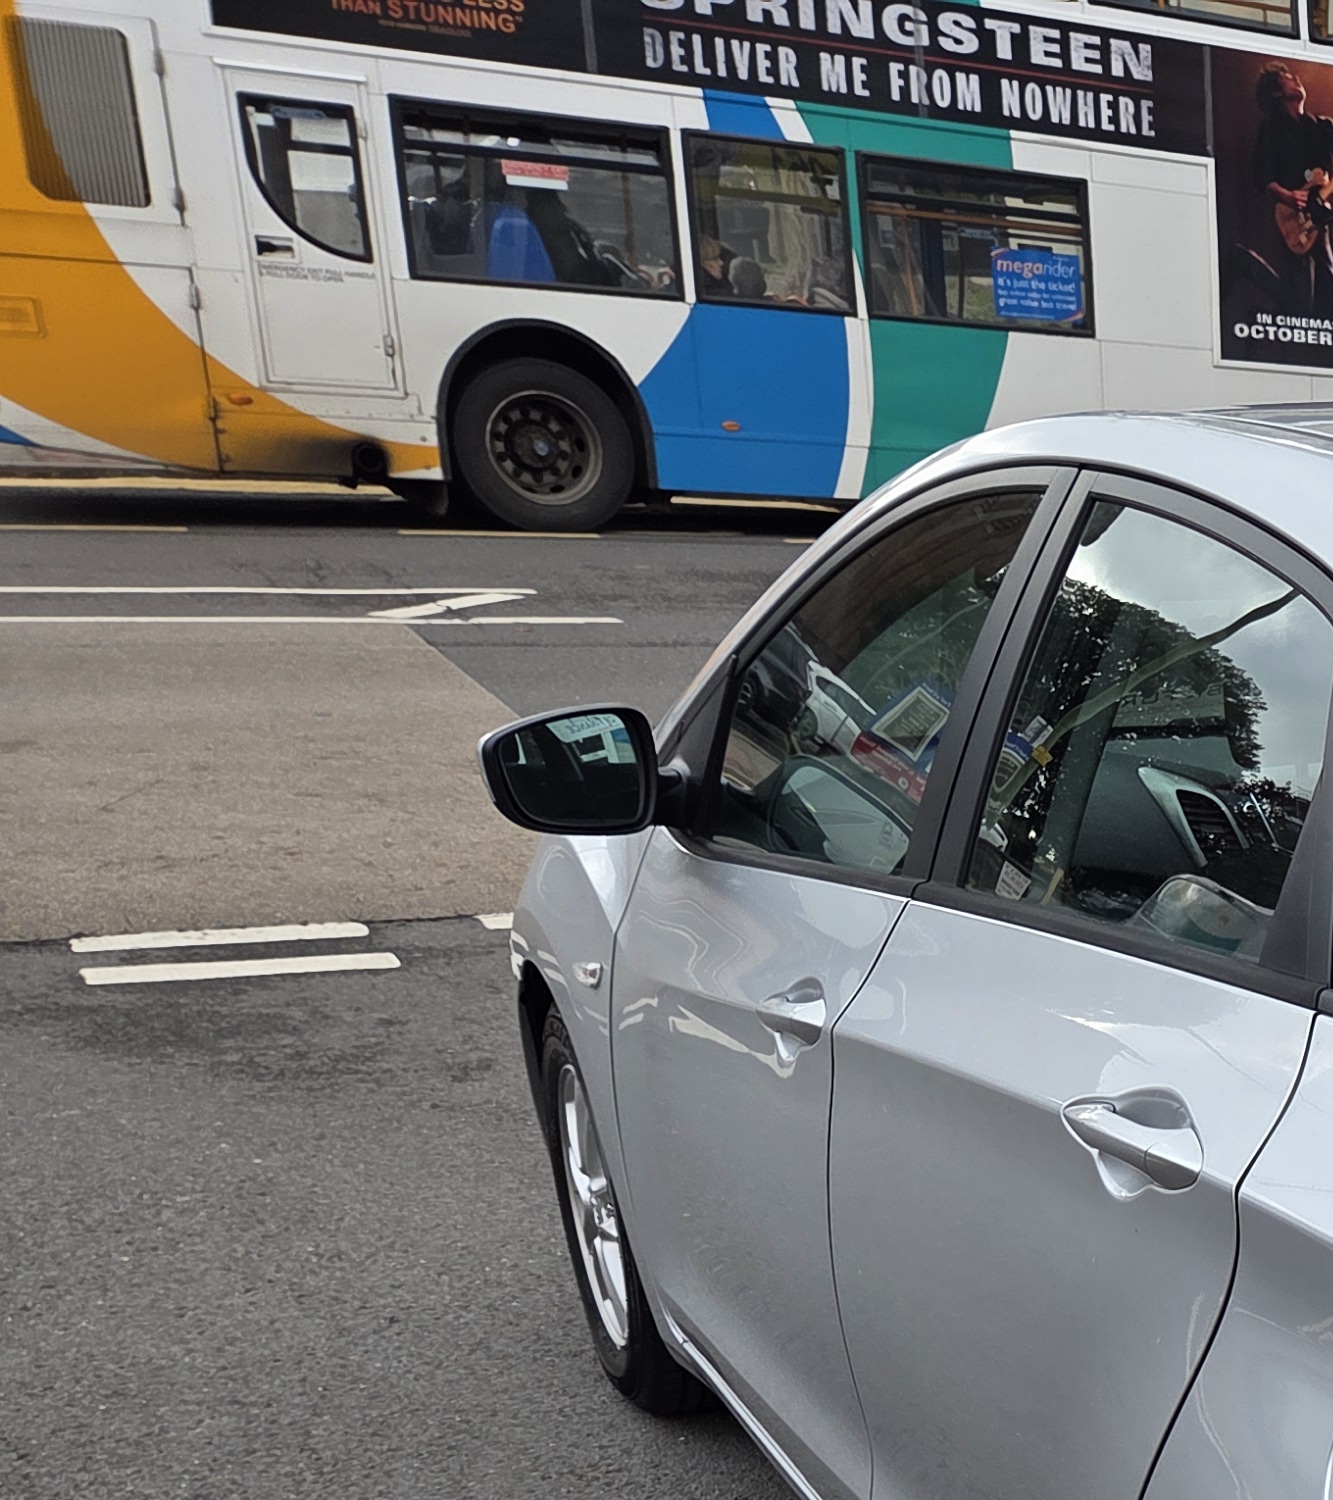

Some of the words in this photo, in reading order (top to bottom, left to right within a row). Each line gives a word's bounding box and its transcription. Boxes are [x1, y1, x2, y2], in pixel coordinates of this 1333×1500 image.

[388, 1, 516, 33] STUNNING
[641, 0, 1153, 82] RINGSTEEN
[643, 27, 799, 87] DELIVER
[820, 52, 870, 97] ME
[889, 62, 982, 112] FROM
[1000, 78, 1155, 137] NOWHERE
[997, 259, 1075, 279] megarider
[1256, 313, 1272, 324] IN
[1234, 323, 1332, 346] OCTOBER
